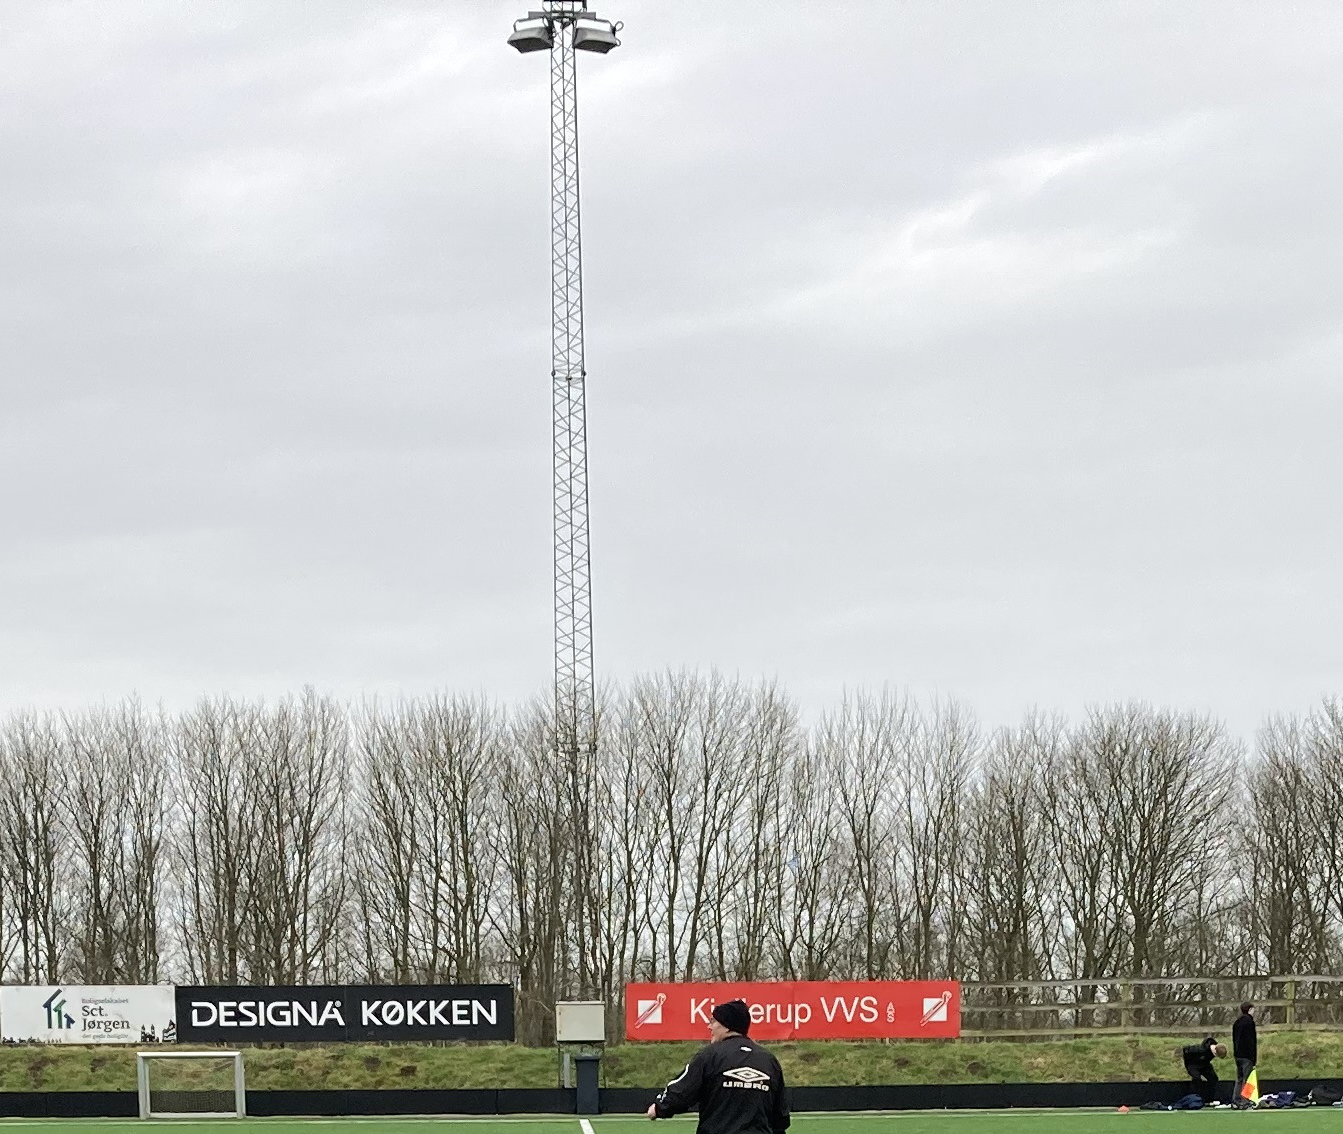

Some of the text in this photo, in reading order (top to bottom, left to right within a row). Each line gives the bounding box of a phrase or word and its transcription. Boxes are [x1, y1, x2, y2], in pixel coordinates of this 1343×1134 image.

[81, 1005, 109, 1017] Sct.
[361, 1000, 497, 1026] KØKKEN
[820, 996, 879, 1023] VVS
[81, 1018, 131, 1033] Jørgen
